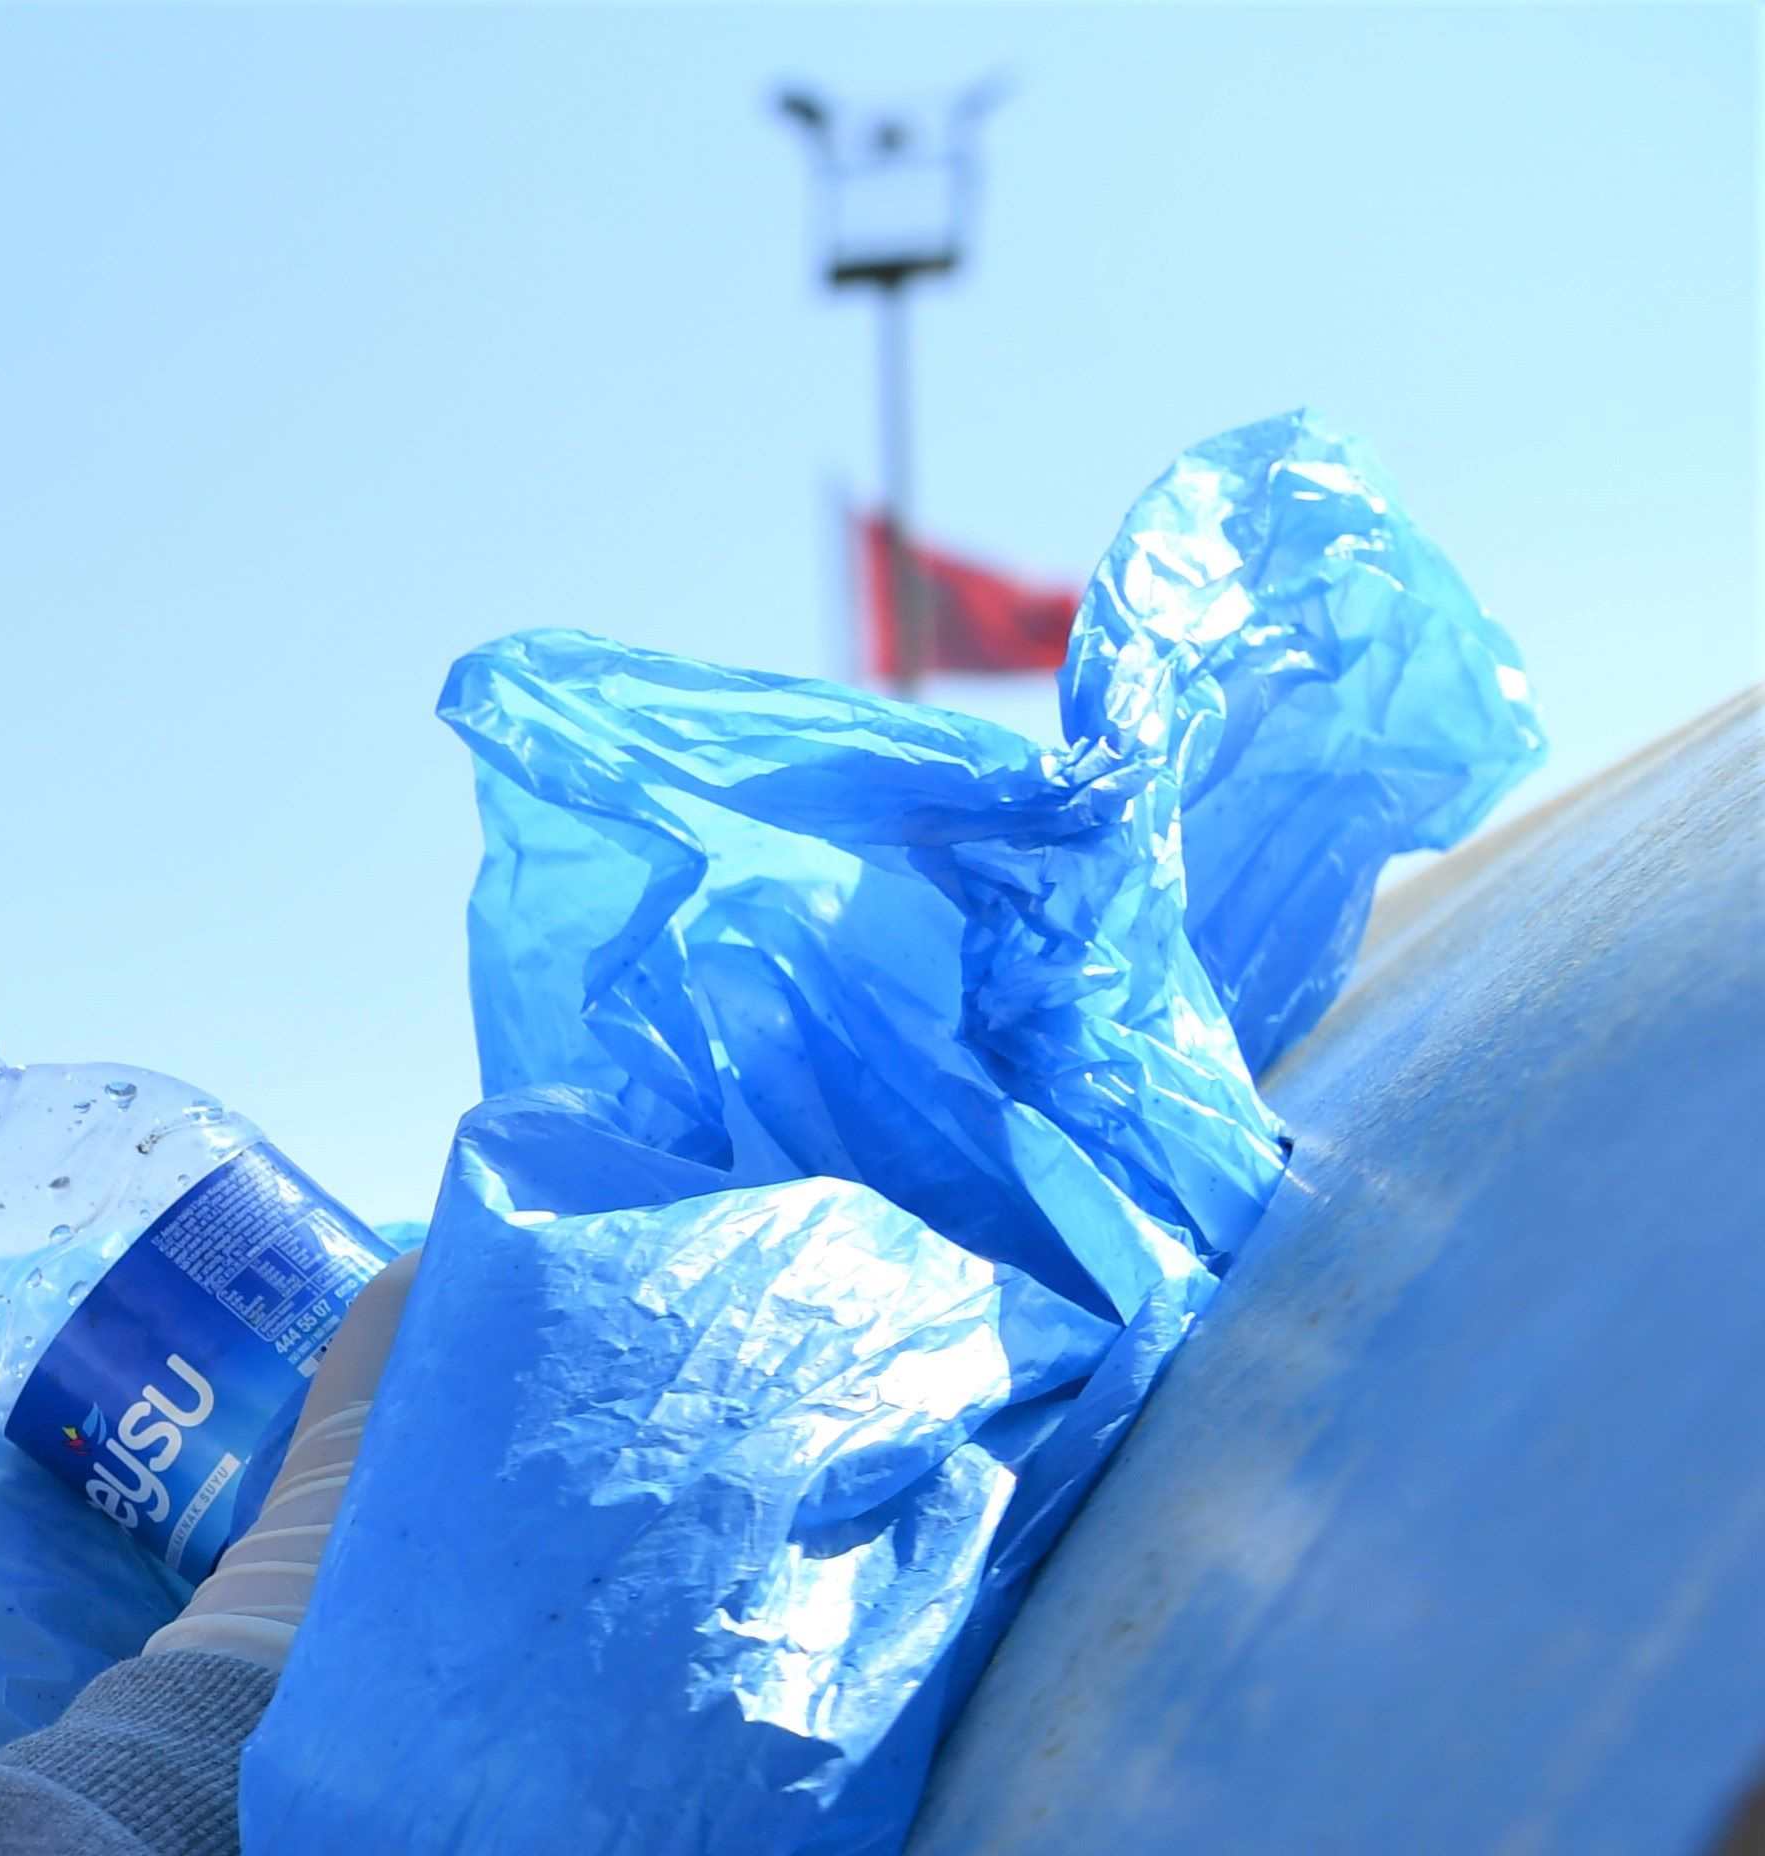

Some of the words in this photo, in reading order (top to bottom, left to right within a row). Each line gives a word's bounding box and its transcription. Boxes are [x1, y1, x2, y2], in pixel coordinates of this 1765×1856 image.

[274, 1327, 302, 1355] 444
[296, 1312, 318, 1333] 55
[312, 1298, 332, 1318] 07
[84, 1353, 215, 1533] eysu
[199, 1466, 229, 1503] SUYU
